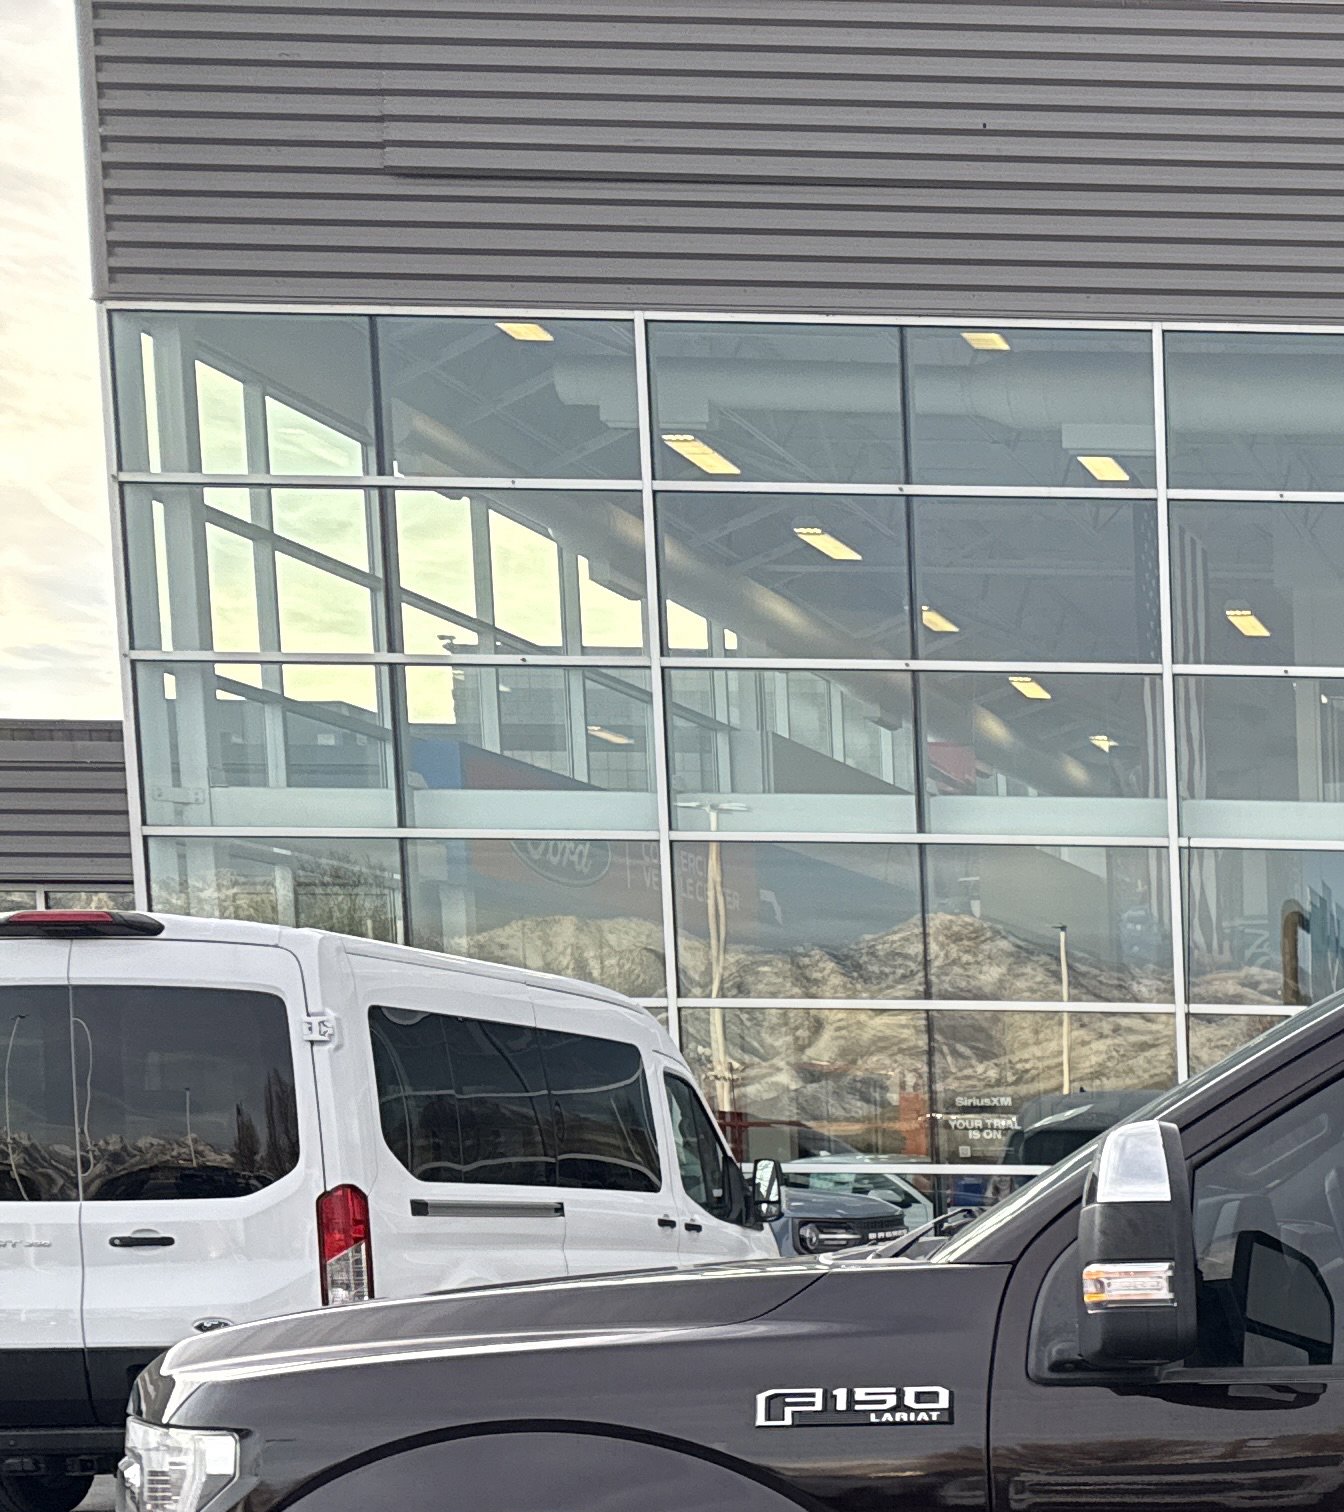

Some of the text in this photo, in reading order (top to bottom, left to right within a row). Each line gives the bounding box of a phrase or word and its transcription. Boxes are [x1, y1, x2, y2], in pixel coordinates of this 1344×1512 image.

[955, 1096, 1013, 1107] SiriusXM
[948, 1119, 1022, 1130] YOUR TRIAL
[968, 1129, 1002, 1140] IS ON
[869, 1410, 941, 1423] LARIAT
